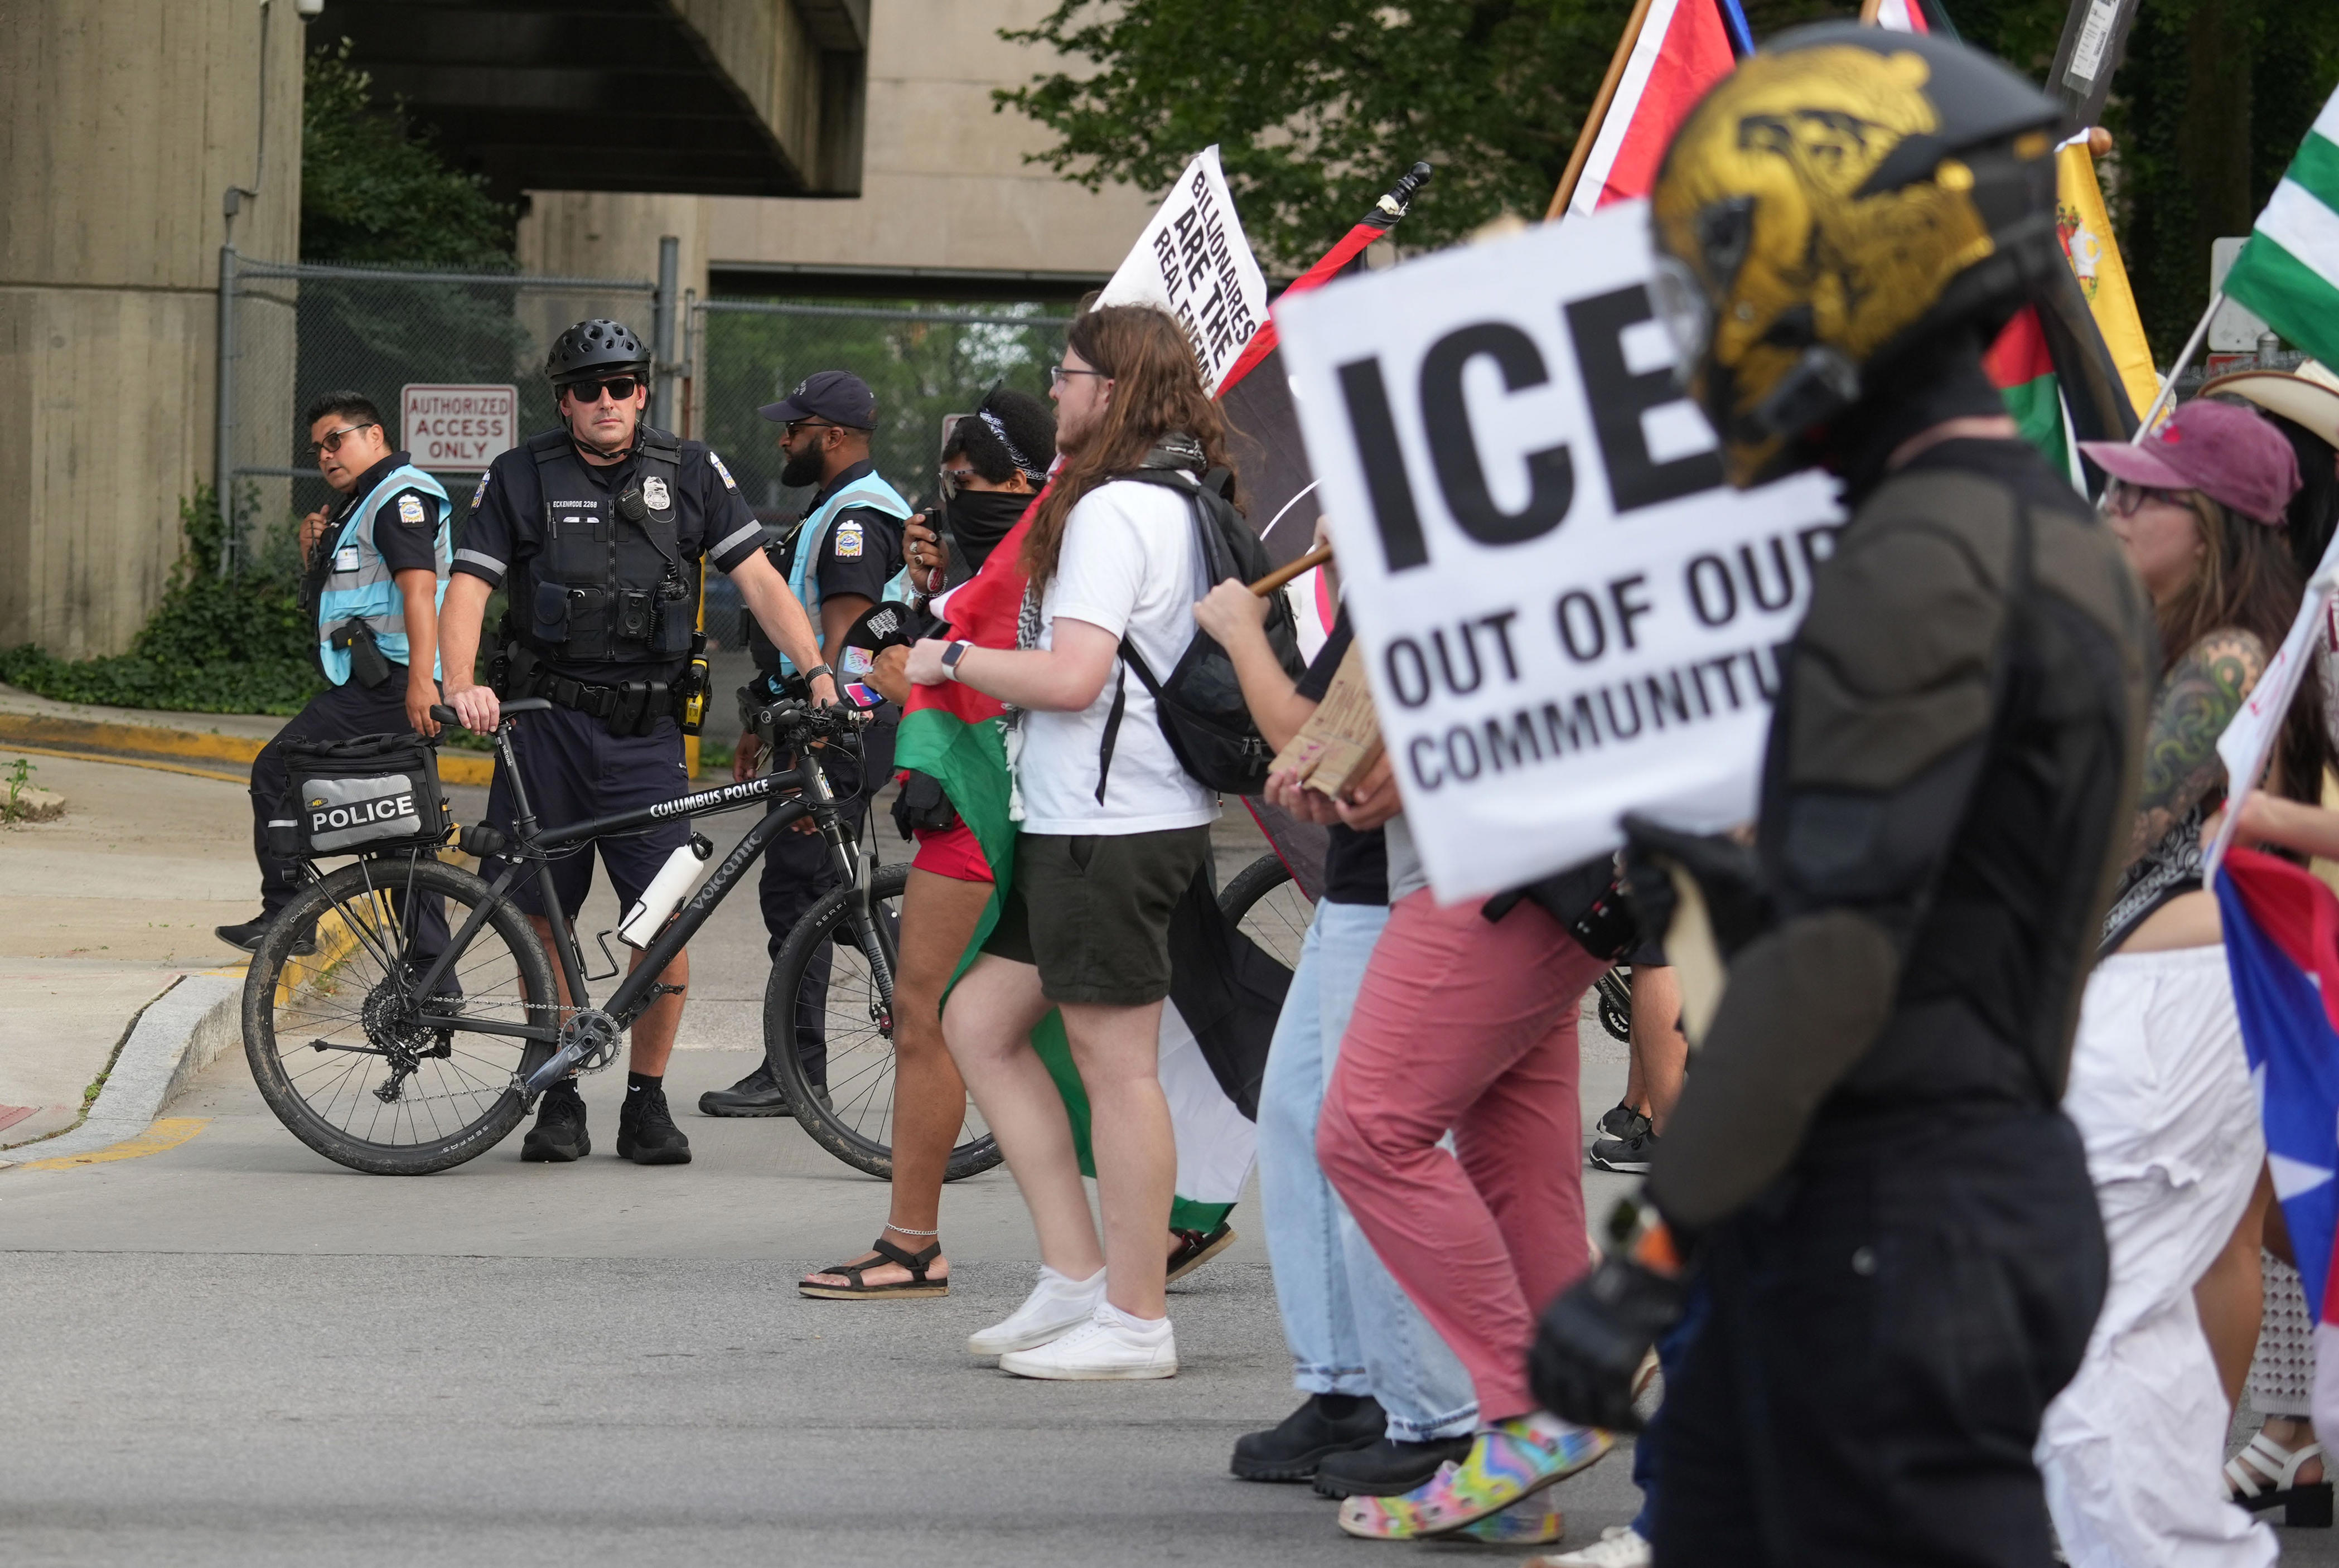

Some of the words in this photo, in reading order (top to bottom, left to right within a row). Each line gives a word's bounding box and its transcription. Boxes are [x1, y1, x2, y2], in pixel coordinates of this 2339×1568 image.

[1153, 226, 1182, 306] REAL
[1191, 171, 1255, 345] BILLIONAIRES
[1175, 205, 1211, 293] ARE
[1201, 280, 1233, 371] THE
[409, 397, 509, 415] AUTHORIZED
[416, 419, 503, 437] ACCESS
[1336, 283, 1725, 574] ICE
[429, 442, 487, 459] ONLY
[1385, 609, 1519, 709] OUT
[1556, 573, 1652, 664] OF
[1408, 643, 1786, 791] COMMUNITI
[502, 744, 512, 767] volcanic
[313, 795, 414, 831] POLICE
[650, 790, 722, 817] COLUMBUS
[724, 778, 770, 801] POLICE
[690, 830, 762, 909] volcanic
[443, 1125, 489, 1153] SERFAS
